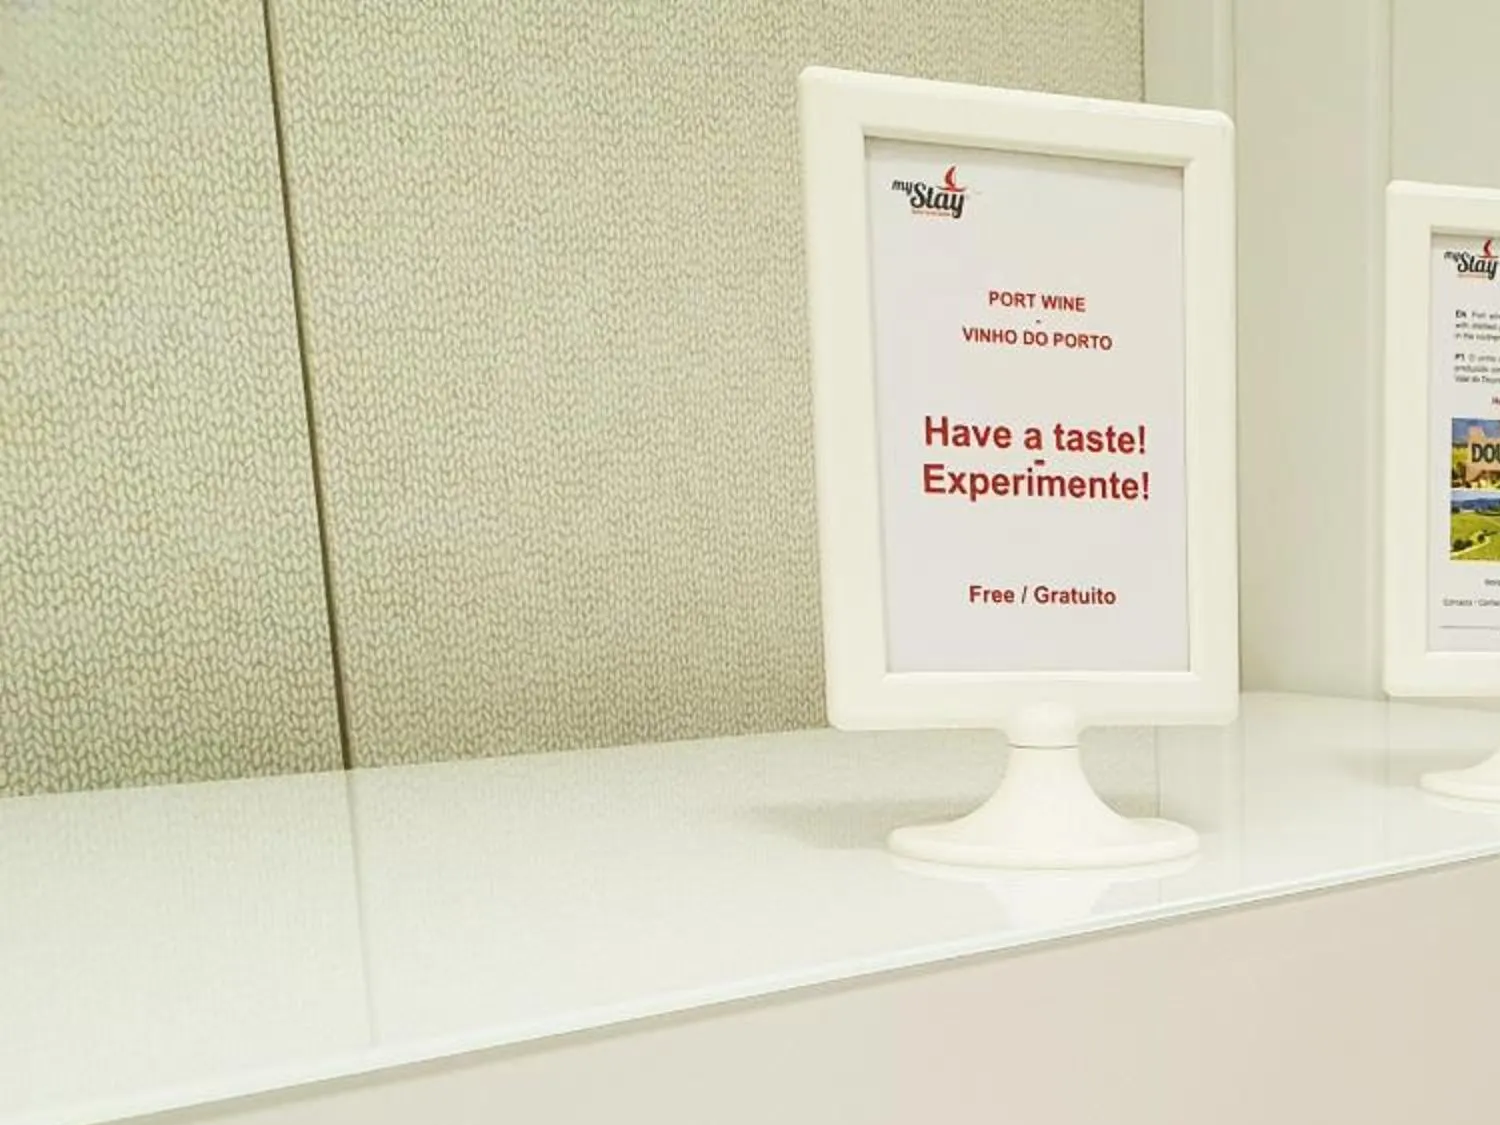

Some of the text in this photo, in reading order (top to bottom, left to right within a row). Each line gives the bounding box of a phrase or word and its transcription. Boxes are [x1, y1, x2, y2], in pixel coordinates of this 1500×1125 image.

[988, 290, 1087, 313] PORT WINE
[962, 326, 1113, 352] VINHO DO PORTO
[925, 415, 1147, 455] Have a taste!
[923, 462, 1150, 503] Experimente!
[969, 584, 1117, 606] Free / Gratuito
